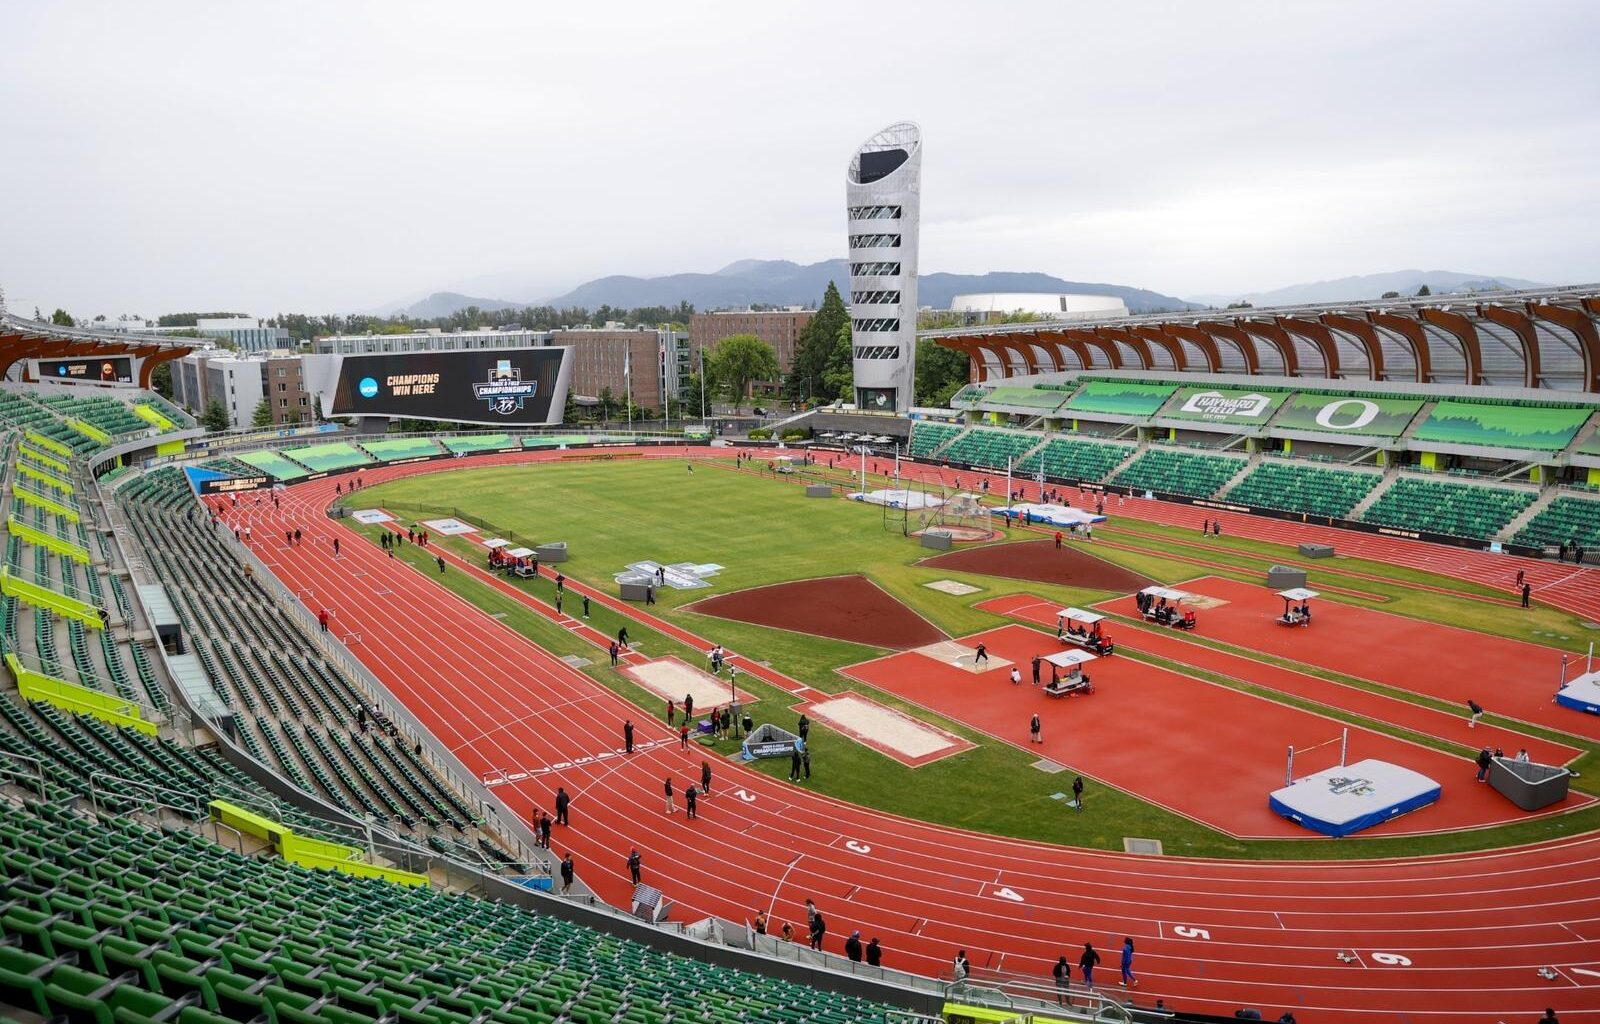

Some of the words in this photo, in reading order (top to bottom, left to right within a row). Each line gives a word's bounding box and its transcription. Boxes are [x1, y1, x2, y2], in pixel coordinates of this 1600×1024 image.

[387, 373, 440, 386] CHAMPIONS
[393, 385, 411, 396] WIN
[412, 384, 436, 395] HERE
[479, 385, 532, 395] CHAMPIONSHIPS
[1197, 397, 1257, 410] HAYWARD
[1204, 406, 1237, 415] FIELD
[1315, 399, 1380, 429] O
[734, 789, 757, 802] 2
[845, 840, 871, 854] 3
[993, 887, 1025, 902] 4
[1174, 925, 1210, 940] 5
[1371, 952, 1412, 966] 6
